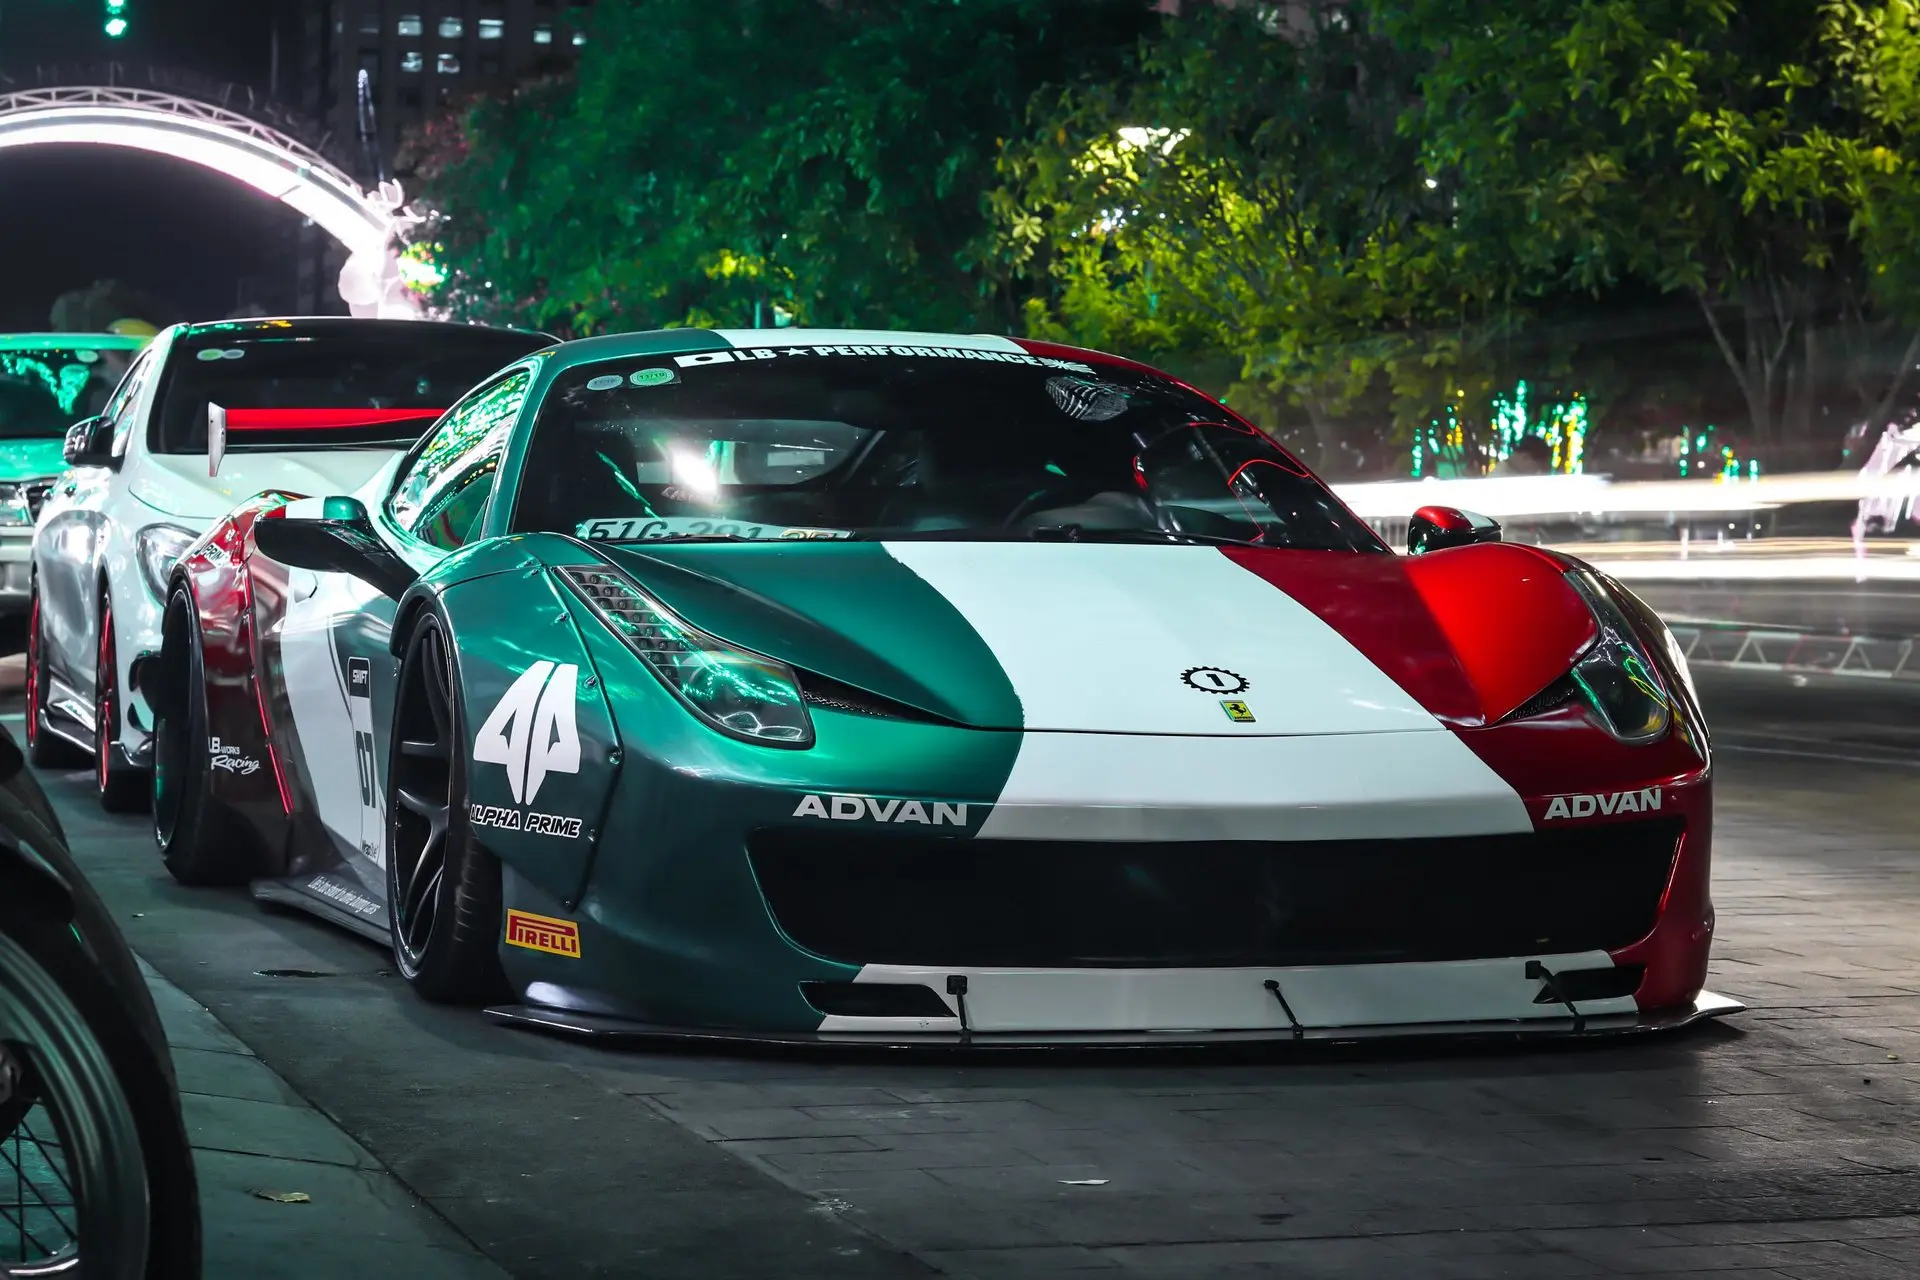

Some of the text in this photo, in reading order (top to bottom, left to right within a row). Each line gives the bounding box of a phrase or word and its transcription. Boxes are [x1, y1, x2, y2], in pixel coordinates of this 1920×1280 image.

[732, 346, 1043, 367] LB PERFORMANCE
[211, 754, 260, 775] Racing
[792, 795, 968, 826] ADVAN
[1544, 788, 1661, 820] ADVAN
[524, 812, 582, 839] PRIME
[508, 914, 577, 954] PIRELLI
